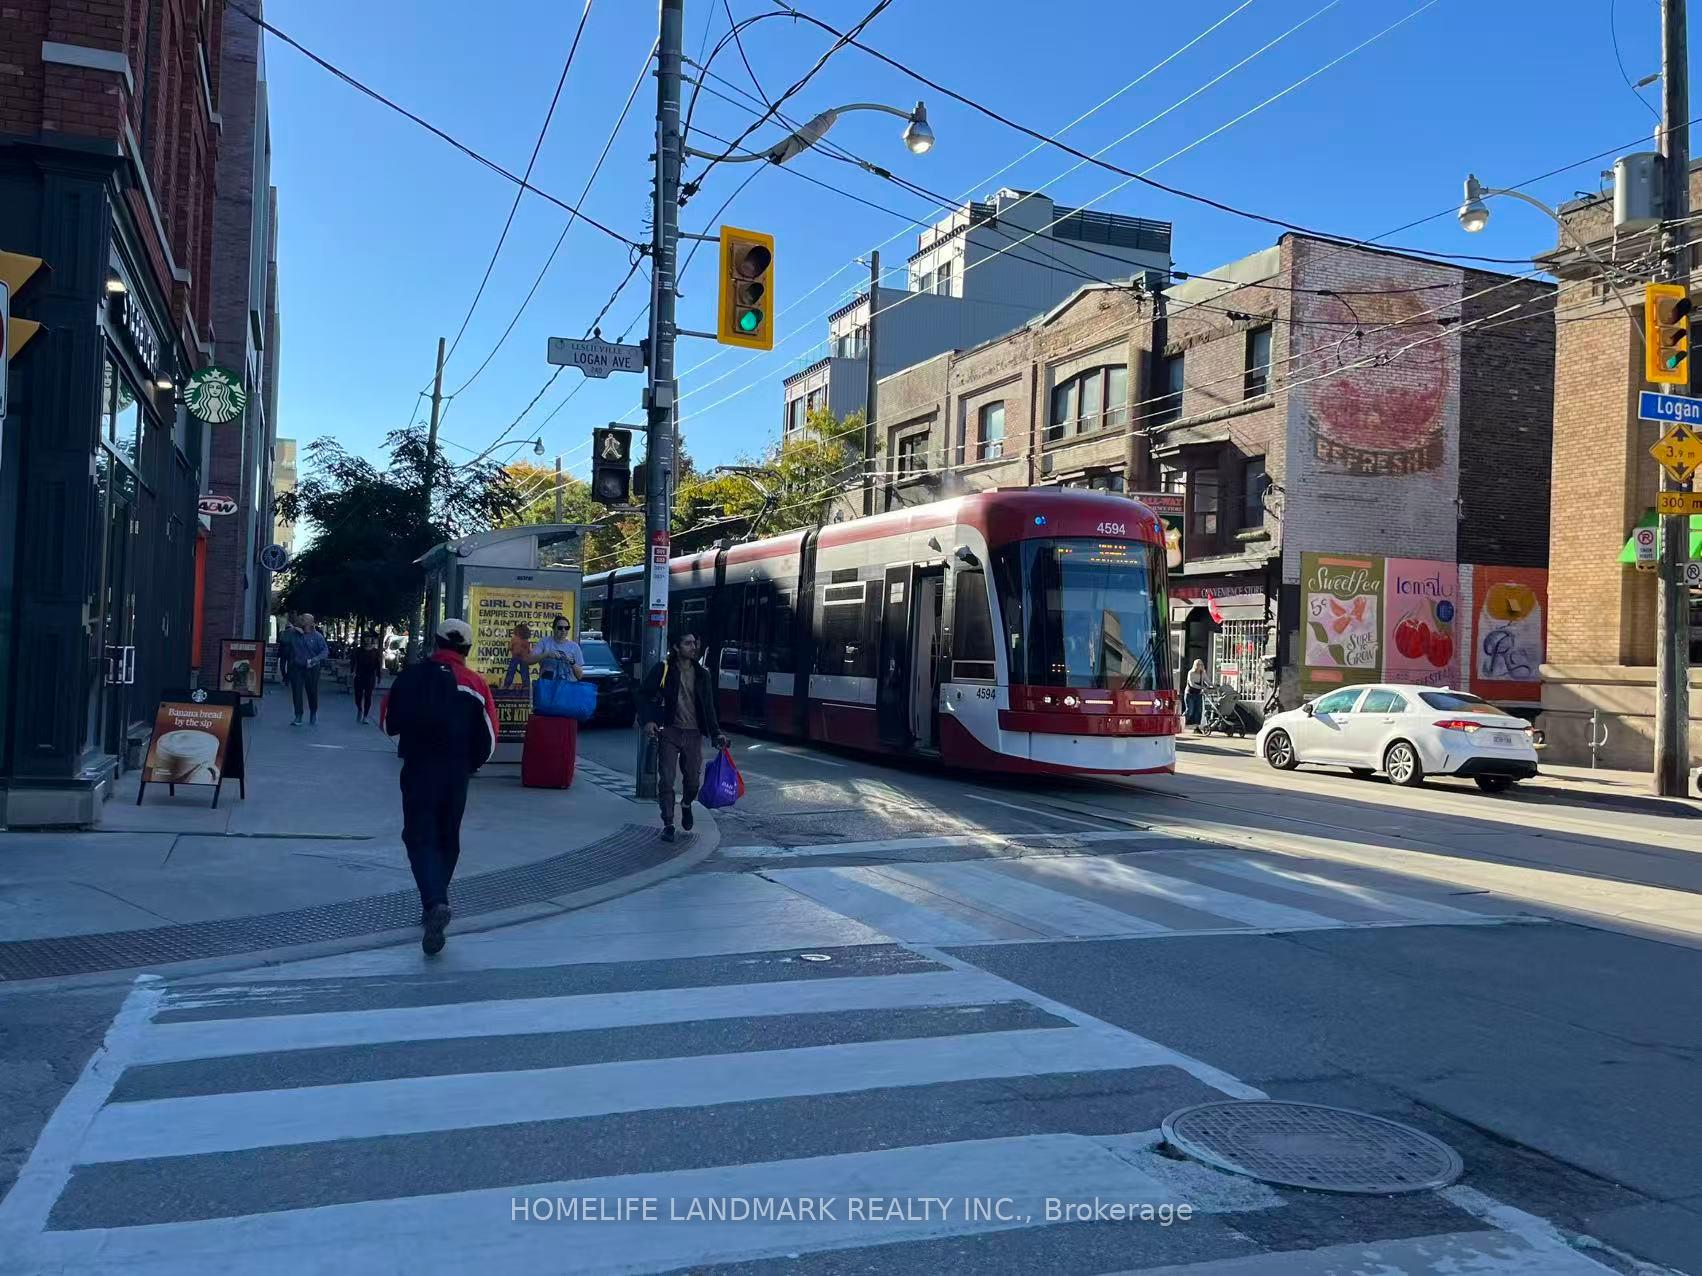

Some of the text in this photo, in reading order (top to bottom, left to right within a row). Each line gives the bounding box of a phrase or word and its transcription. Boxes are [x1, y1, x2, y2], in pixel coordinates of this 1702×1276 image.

[574, 352, 632, 369] LOGAN AVE
[1657, 396, 1700, 421] Logan
[1665, 446, 1684, 458] 3.9
[198, 501, 235, 513] A&W
[1662, 497, 1685, 508] 300
[1096, 522, 1126, 535] 4594
[479, 599, 563, 611] GIRL ON FIRE
[479, 609, 509, 618] EMPIRE
[509, 610, 533, 619] STATE
[533, 611, 543, 619] OF
[478, 627, 493, 637] NO
[1347, 632, 1373, 650] SURE
[478, 646, 510, 657] KNOW
[1346, 646, 1378, 666] GROW
[976, 687, 997, 700] 4594
[168, 707, 223, 719] Banana bread
[175, 717, 213, 729] by the sip
